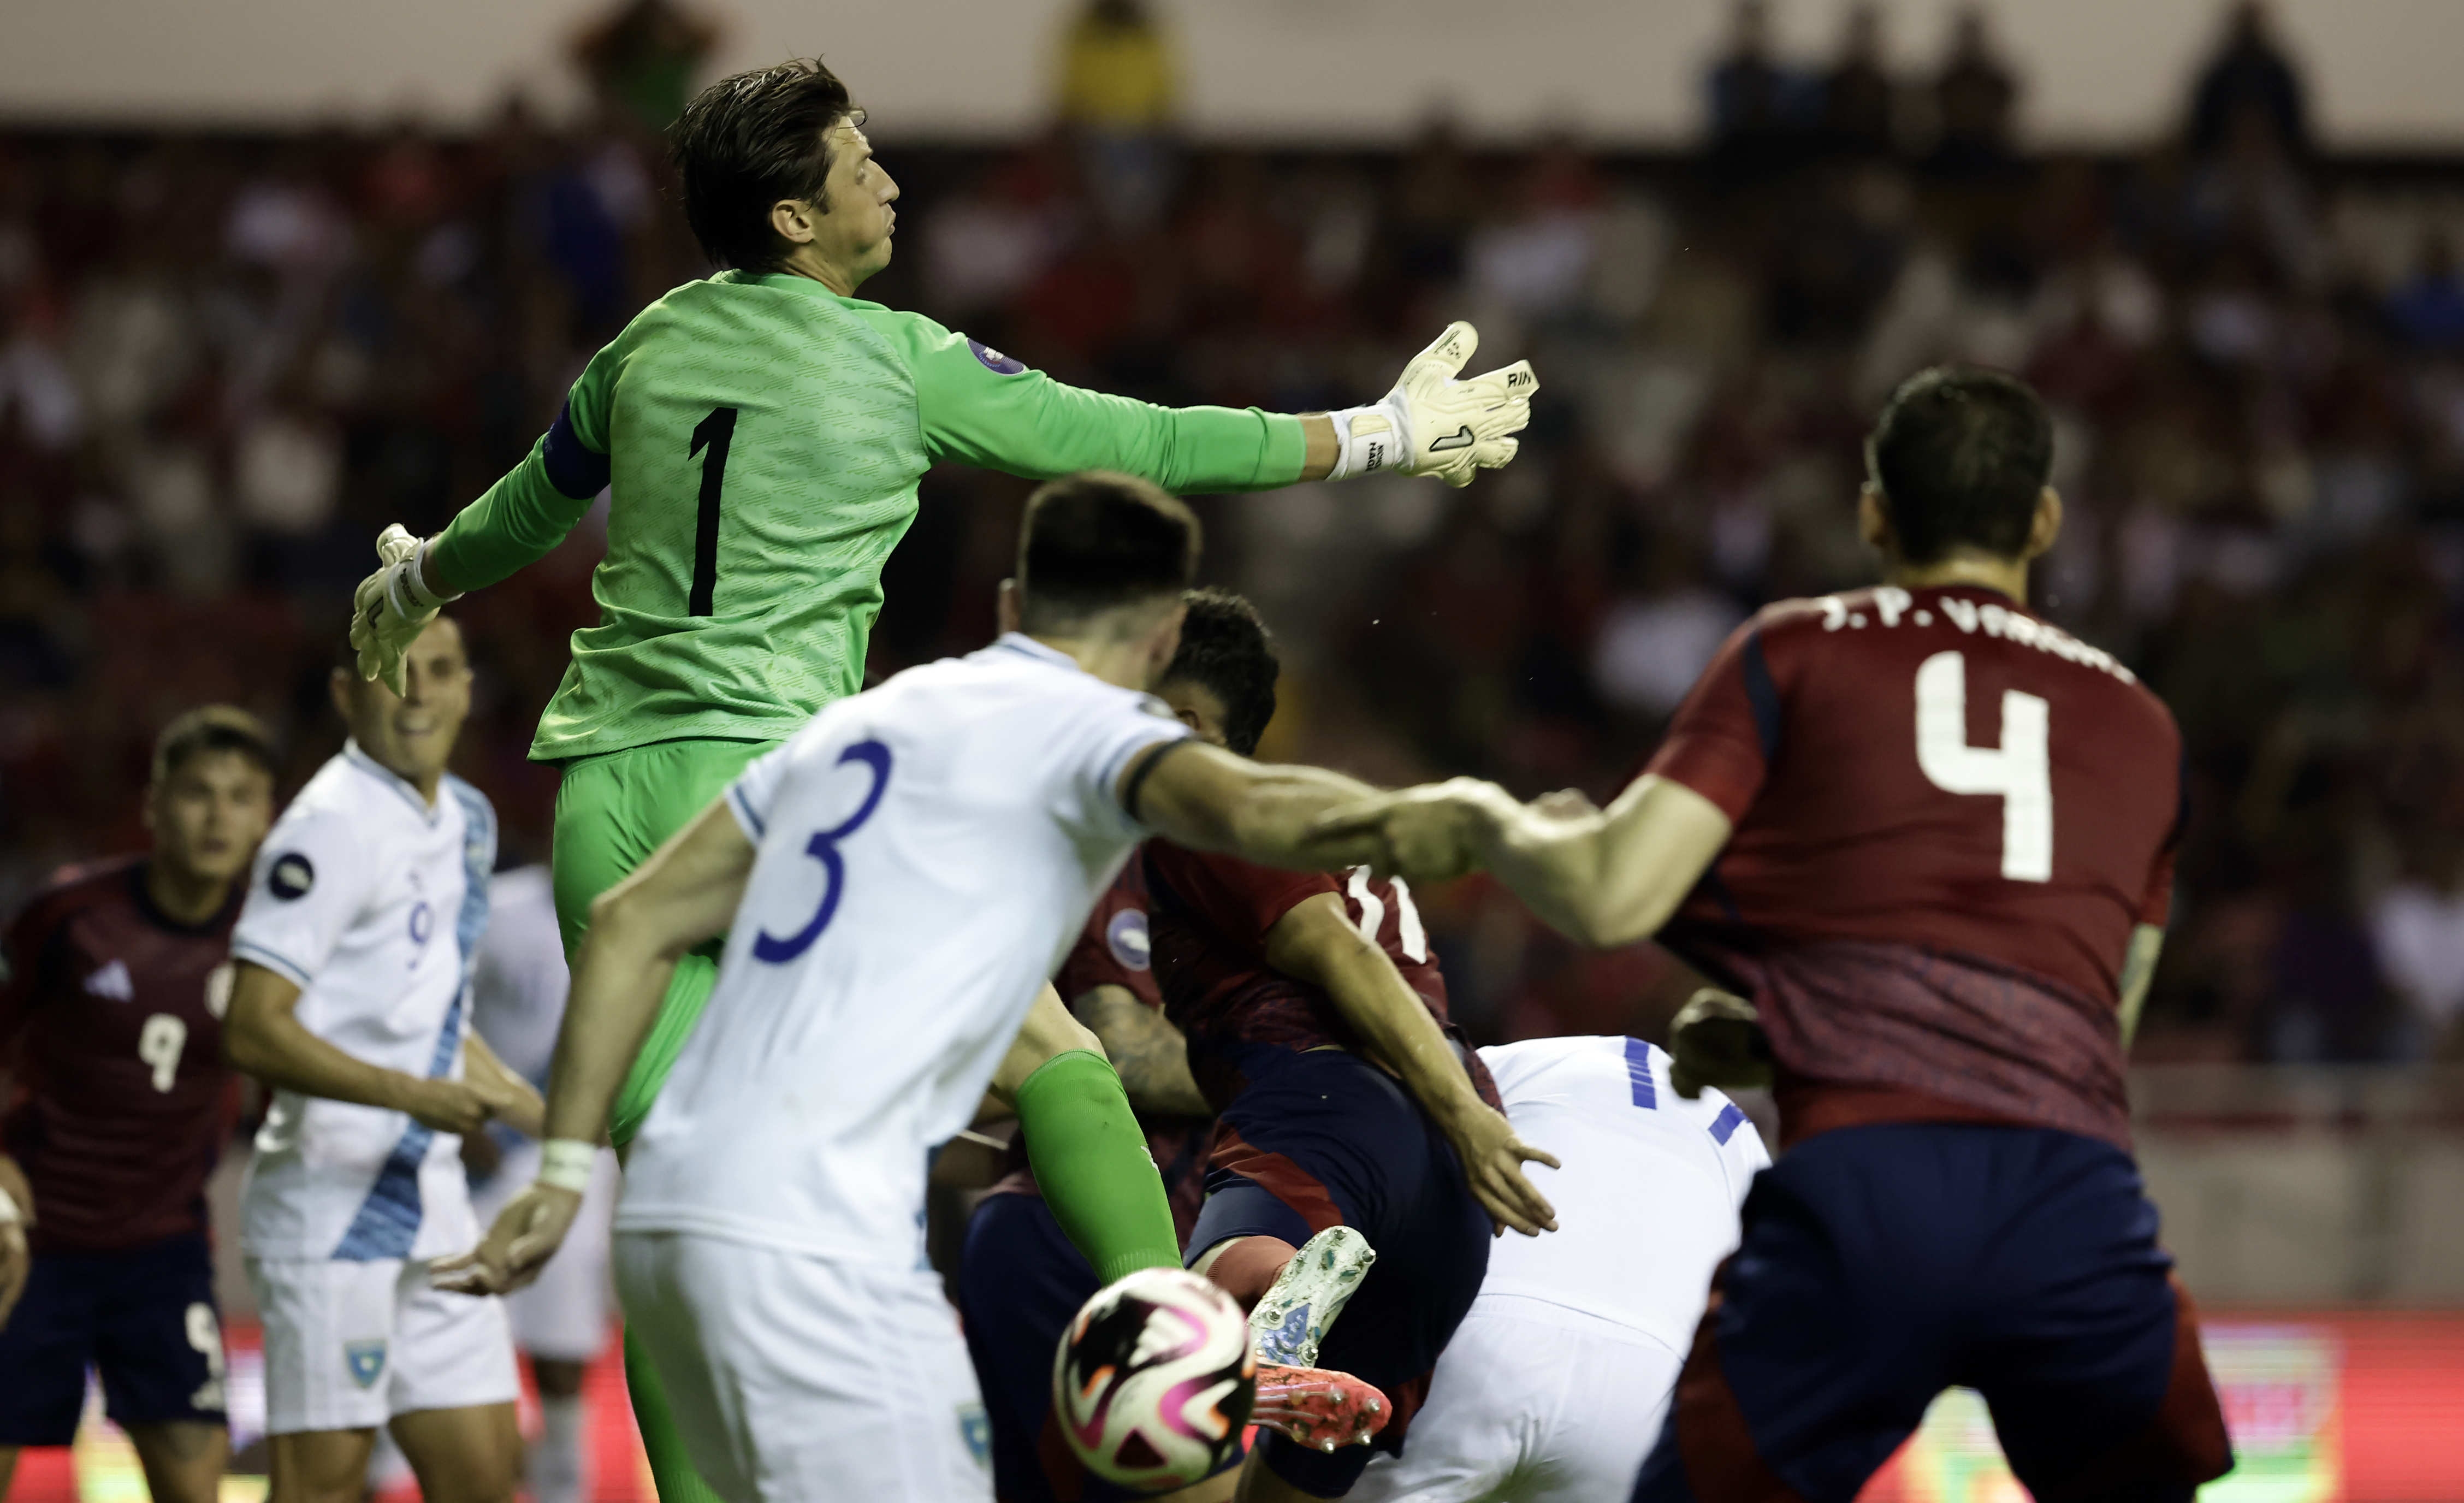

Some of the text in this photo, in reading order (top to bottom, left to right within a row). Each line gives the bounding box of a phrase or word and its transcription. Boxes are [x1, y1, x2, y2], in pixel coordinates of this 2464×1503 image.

[688, 406, 738, 617] 1
[1873, 587, 1933, 628] P.
[1916, 652, 2053, 881] 4
[751, 739, 893, 967] 3
[408, 901, 435, 971] 9
[139, 1013, 188, 1093] 9
